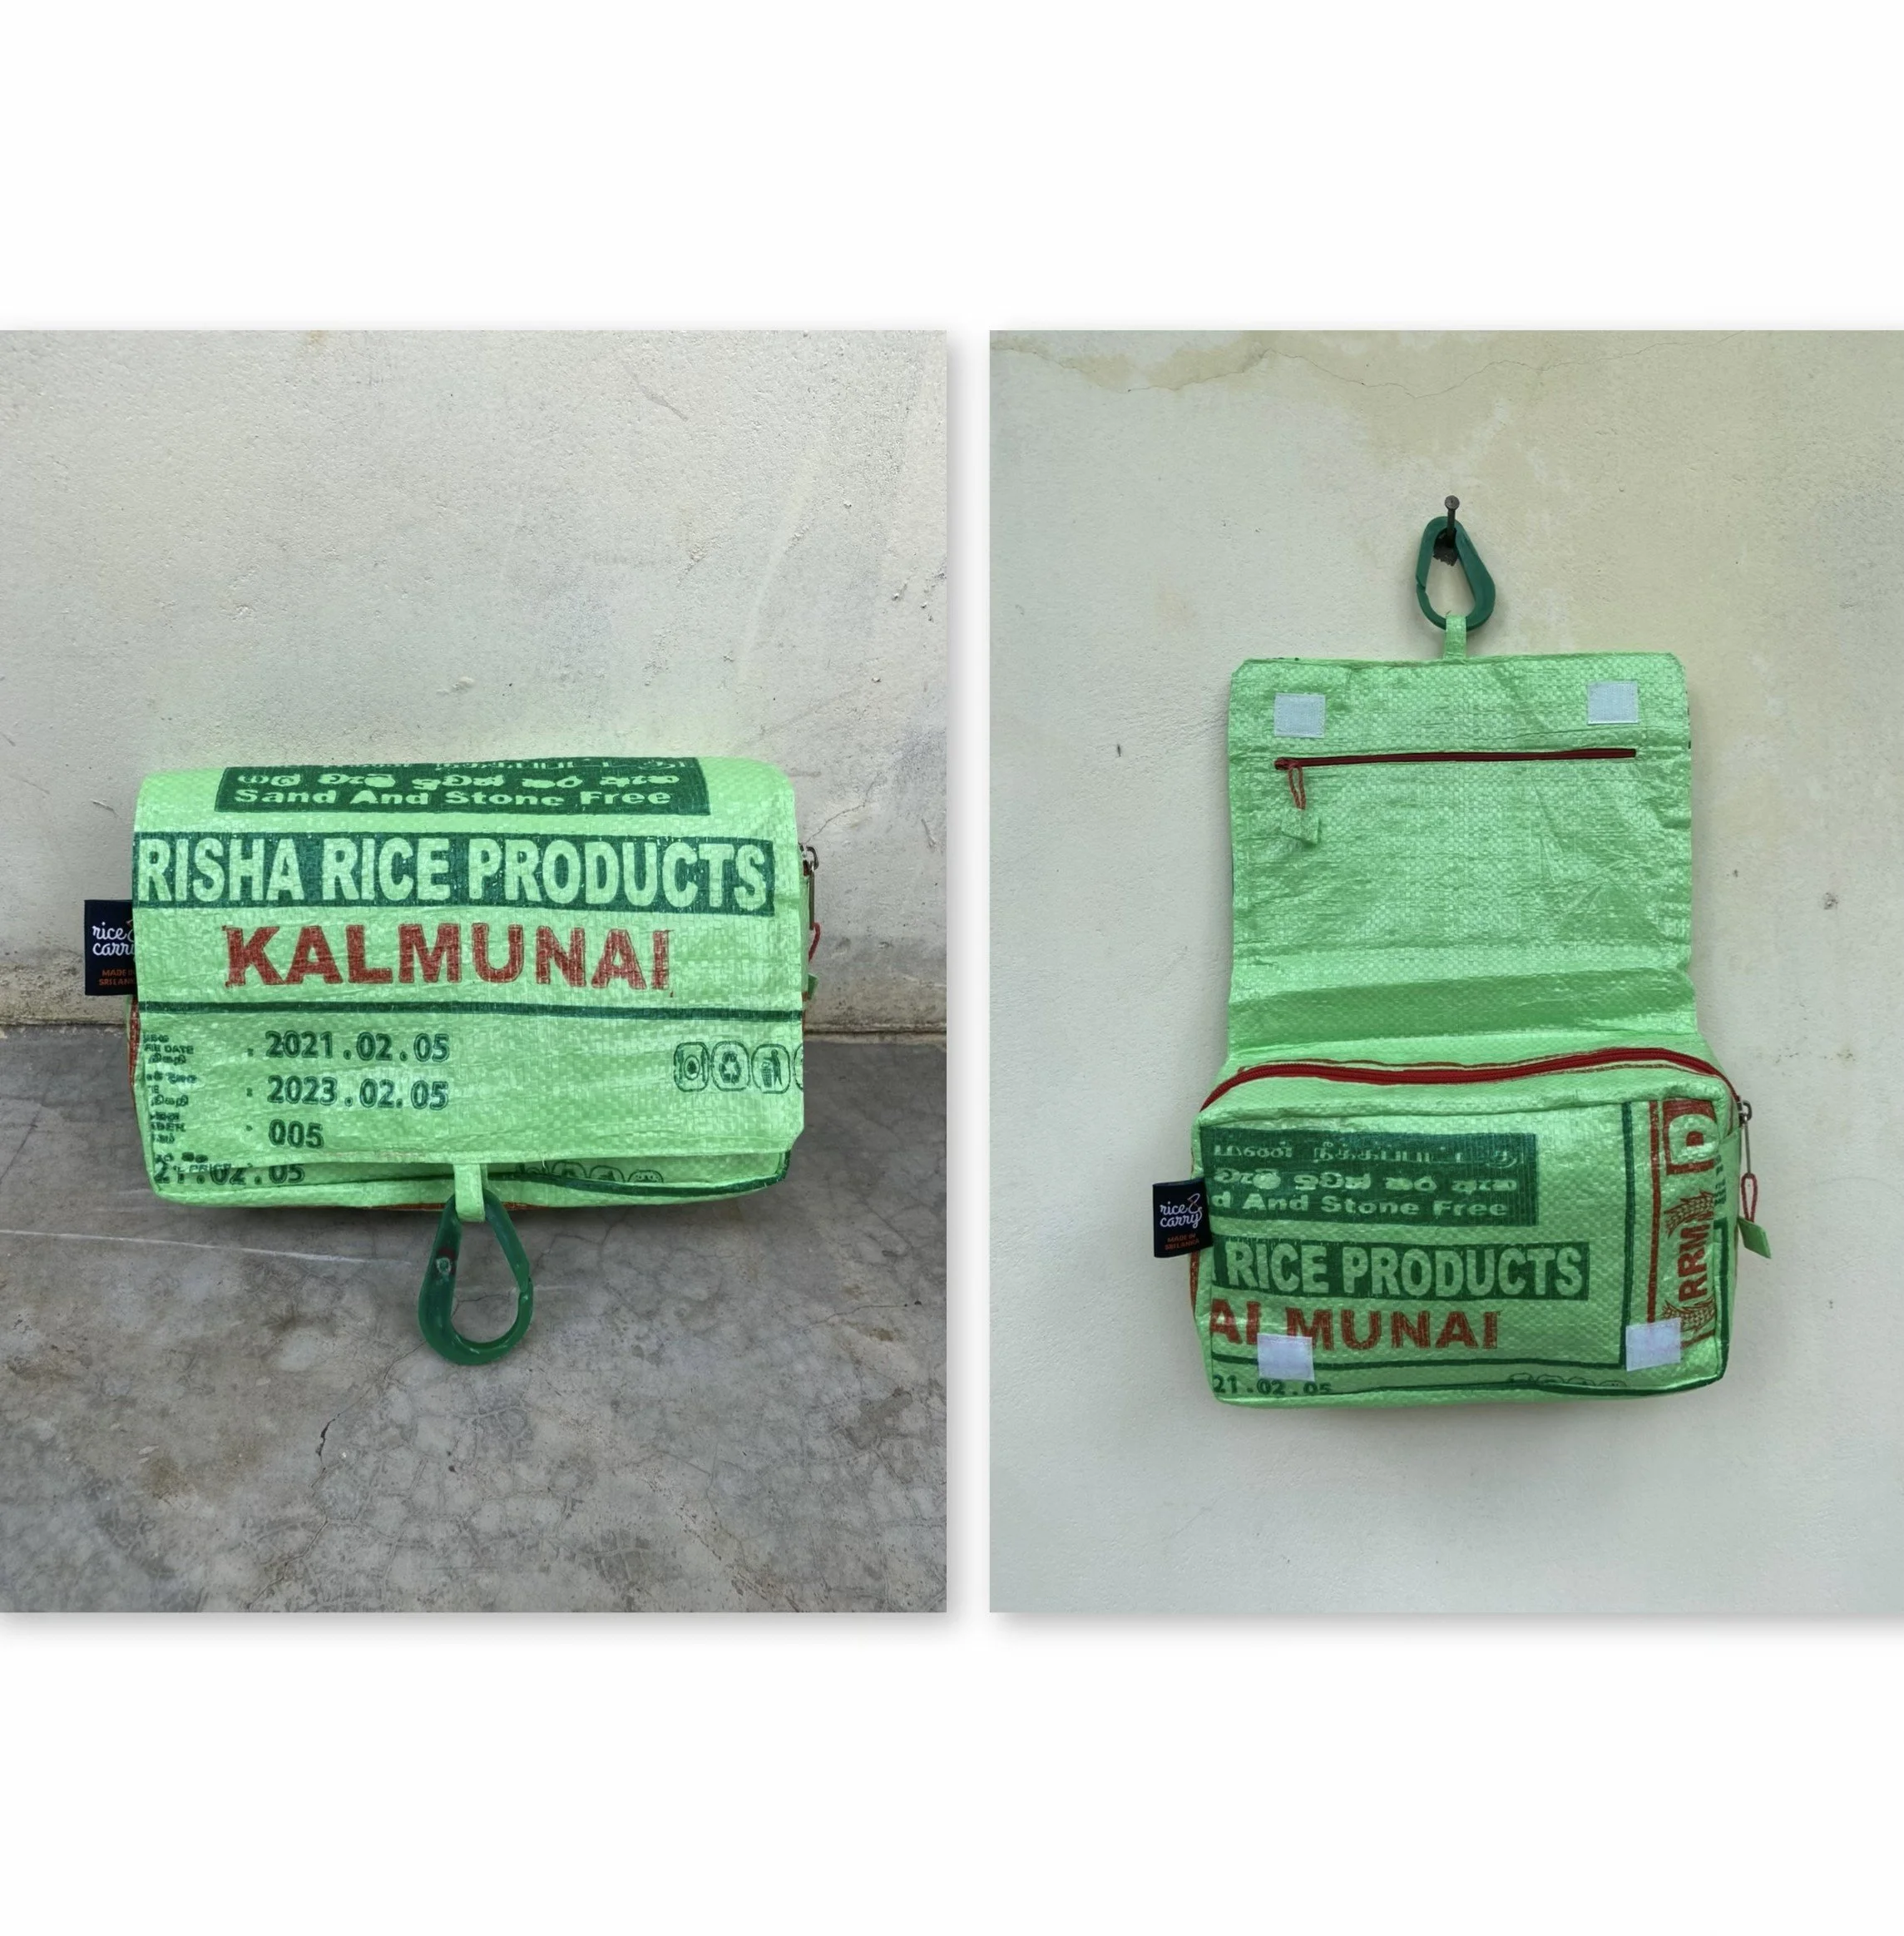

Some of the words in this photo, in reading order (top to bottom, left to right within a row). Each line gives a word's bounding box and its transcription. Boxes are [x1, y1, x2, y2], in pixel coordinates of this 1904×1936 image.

[234, 790, 337, 804] Sand
[349, 790, 429, 805] And
[445, 791, 565, 805] Stone
[580, 790, 671, 805] Free
[136, 837, 305, 902] RISHA
[321, 837, 451, 902] RICE
[468, 838, 766, 910] PRODUCTS
[91, 921, 127, 940] rice
[222, 923, 672, 990] KALMUNAI
[265, 1030, 450, 1062] 2021.02.05
[266, 1075, 449, 1111] 2023.02.05
[268, 1118, 324, 1149] 005
[1160, 1201, 1188, 1216] rice
[1243, 1194, 1308, 1211] And
[1321, 1195, 1419, 1215] Stone
[1433, 1201, 1508, 1216] Free
[1160, 1214, 1203, 1229] carry
[1225, 1244, 1329, 1293] RICE
[1343, 1246, 1585, 1296] PRODUCTS
